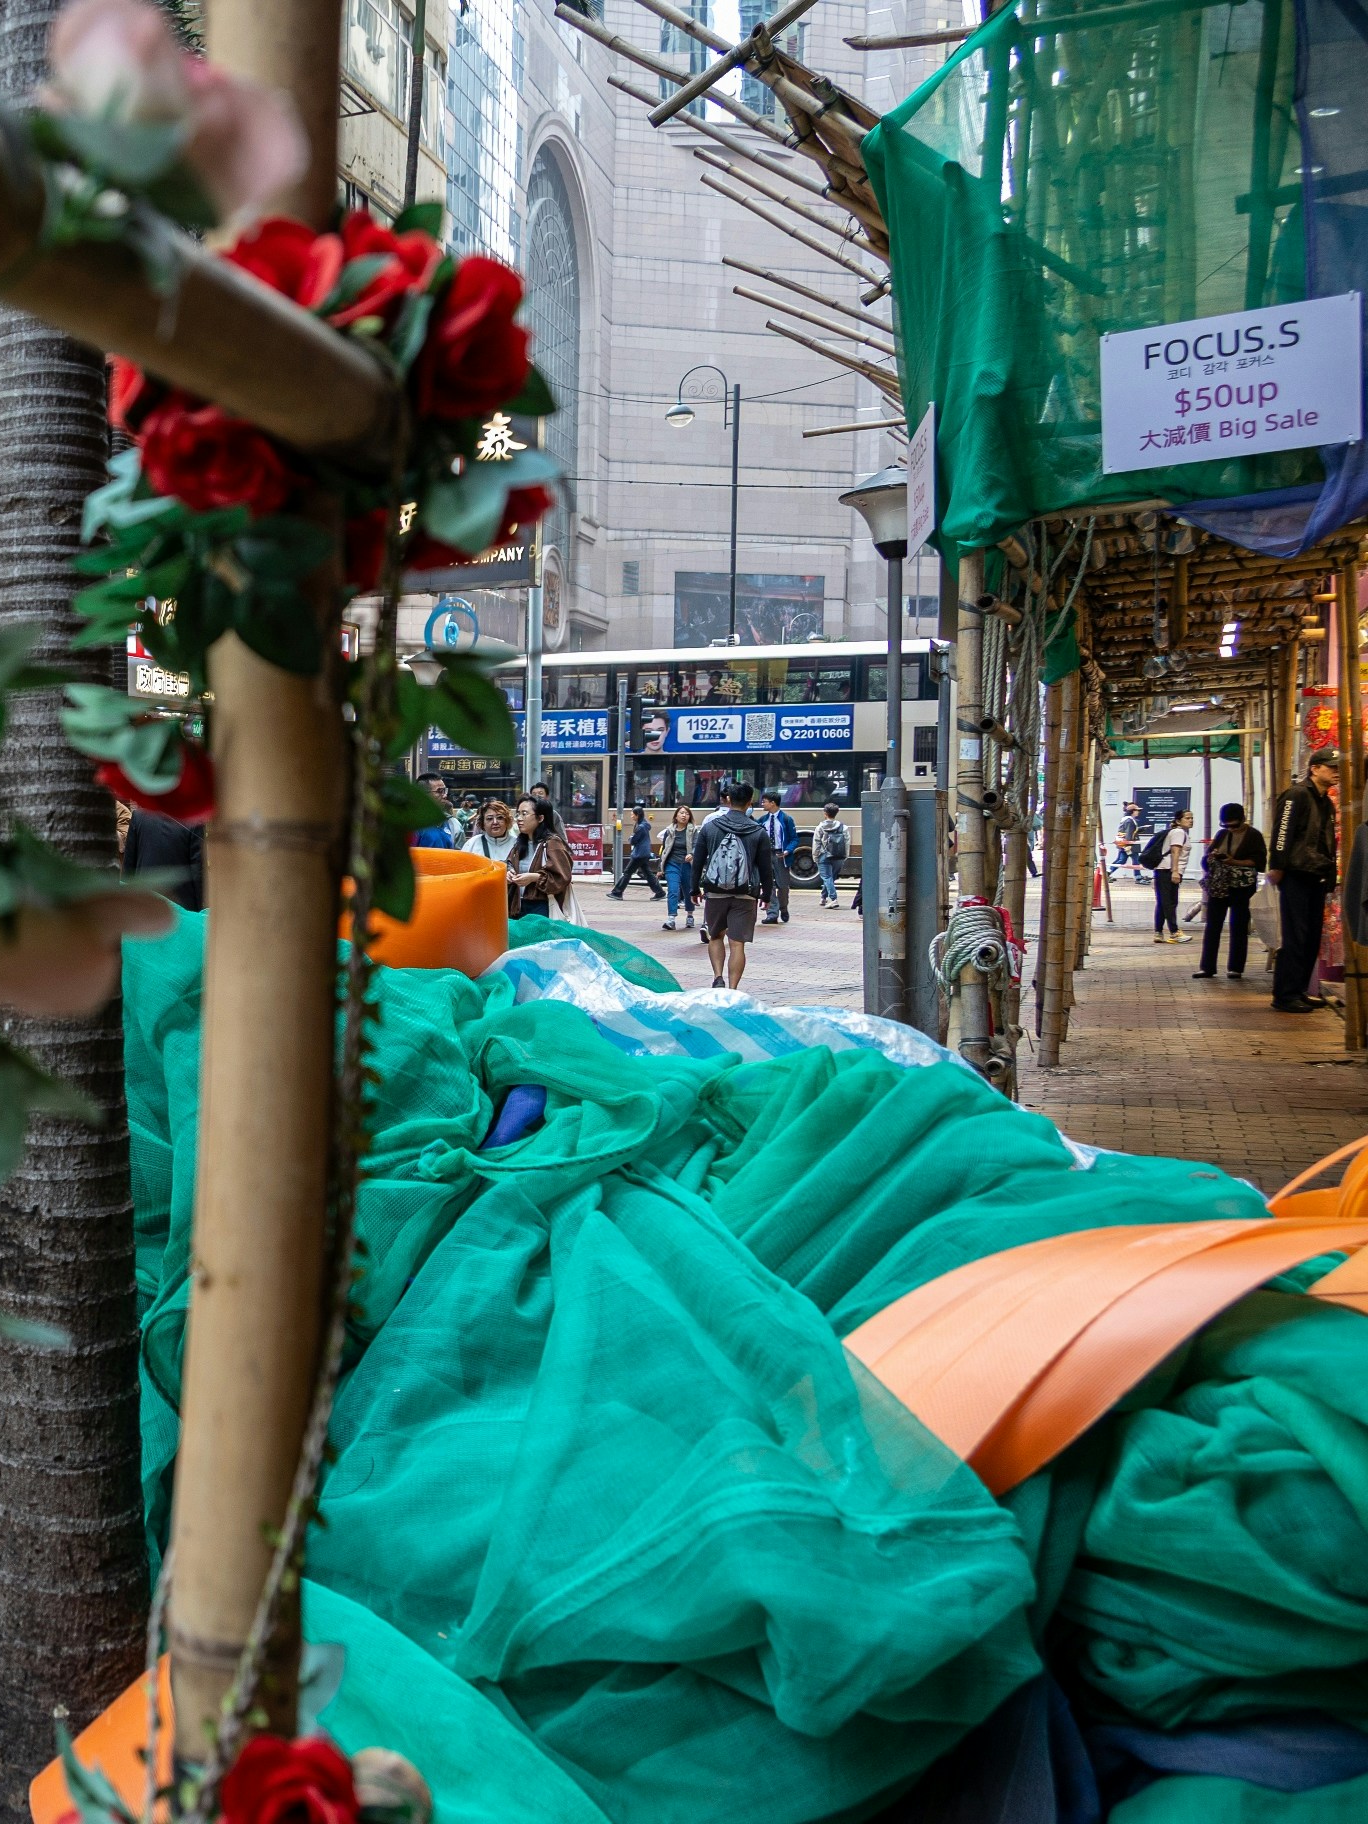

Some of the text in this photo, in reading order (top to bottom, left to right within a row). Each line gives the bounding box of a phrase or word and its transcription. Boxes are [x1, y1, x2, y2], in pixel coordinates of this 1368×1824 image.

[1144, 319, 1300, 370] FOCUS.S
[1166, 355, 1275, 380] 코디 감각 포커스
[1174, 381, 1279, 417] $50up
[1139, 408, 1319, 451] 大減價 Big Sale
